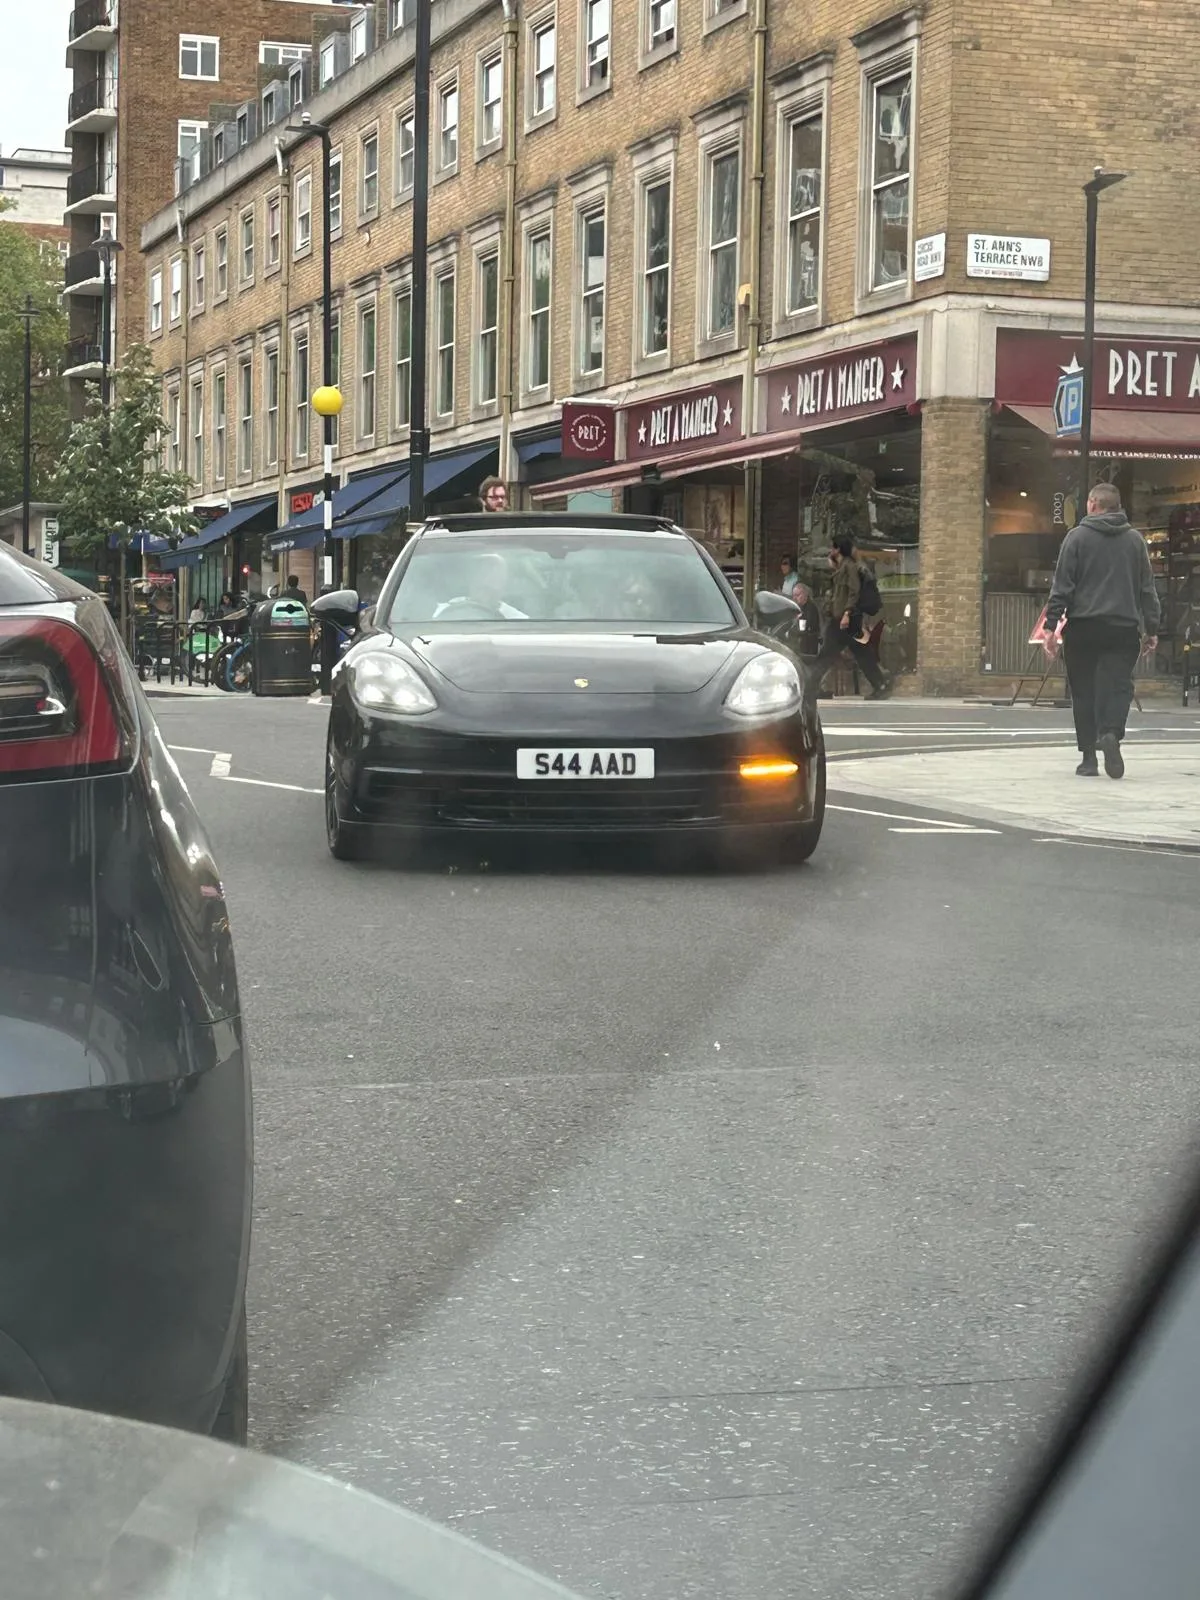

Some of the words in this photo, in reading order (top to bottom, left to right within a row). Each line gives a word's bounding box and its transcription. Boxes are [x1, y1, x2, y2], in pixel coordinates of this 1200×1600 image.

[974, 239, 989, 251] ST.
[991, 240, 1022, 252] ANN'S
[974, 251, 1018, 265] TERRACE
[796, 367, 825, 417] PRET
[825, 373, 834, 410] A
[836, 356, 885, 408] MANGER
[1108, 349, 1177, 397] PRET
[578, 425, 600, 441] PRET
[649, 405, 671, 446] PRET
[672, 413, 680, 442] A
[681, 395, 718, 440] MANGER
[1053, 492, 1064, 524] Good
[42, 519, 57, 564] Library
[535, 753, 582, 775] S44
[590, 753, 636, 775] AAD
